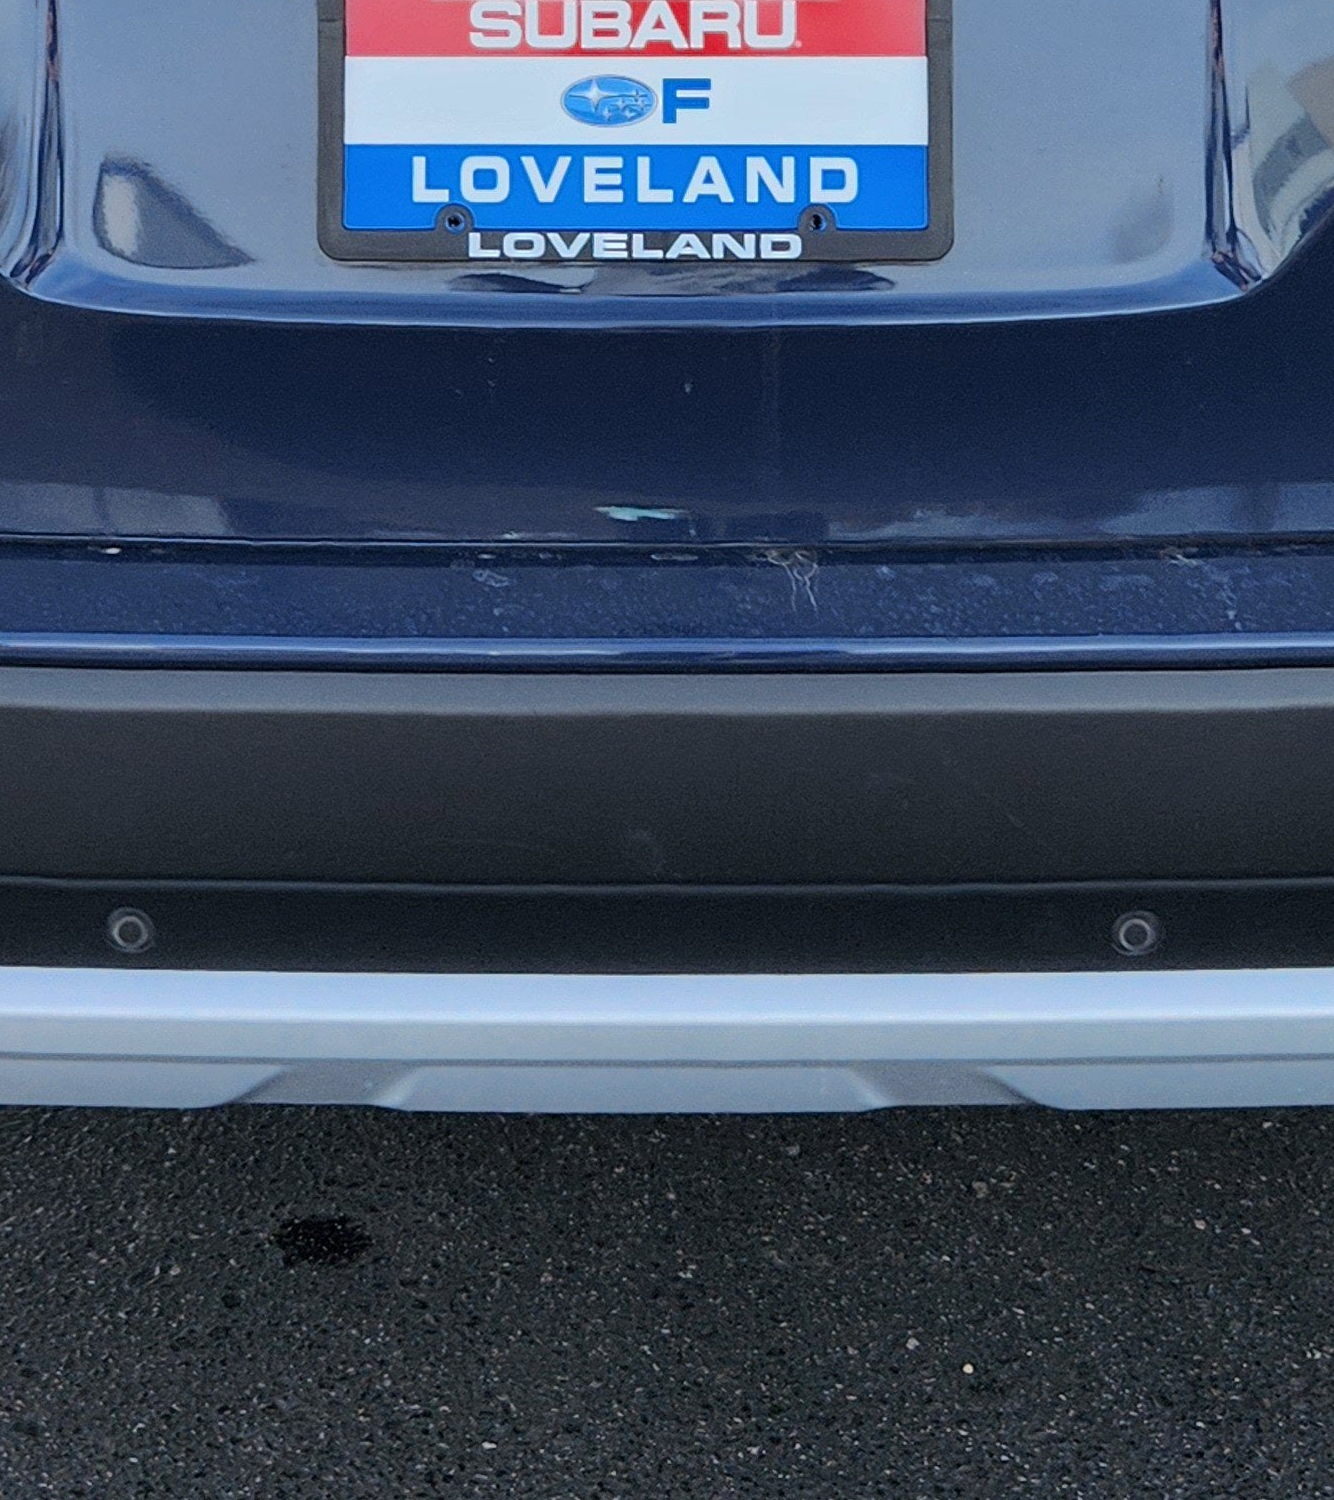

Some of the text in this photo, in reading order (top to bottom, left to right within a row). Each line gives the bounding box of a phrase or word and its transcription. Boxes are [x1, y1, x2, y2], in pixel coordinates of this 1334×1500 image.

[468, 0, 801, 49] SUBARU
[412, 156, 859, 204] LOVELAND
[468, 231, 803, 260] LOVELAND
